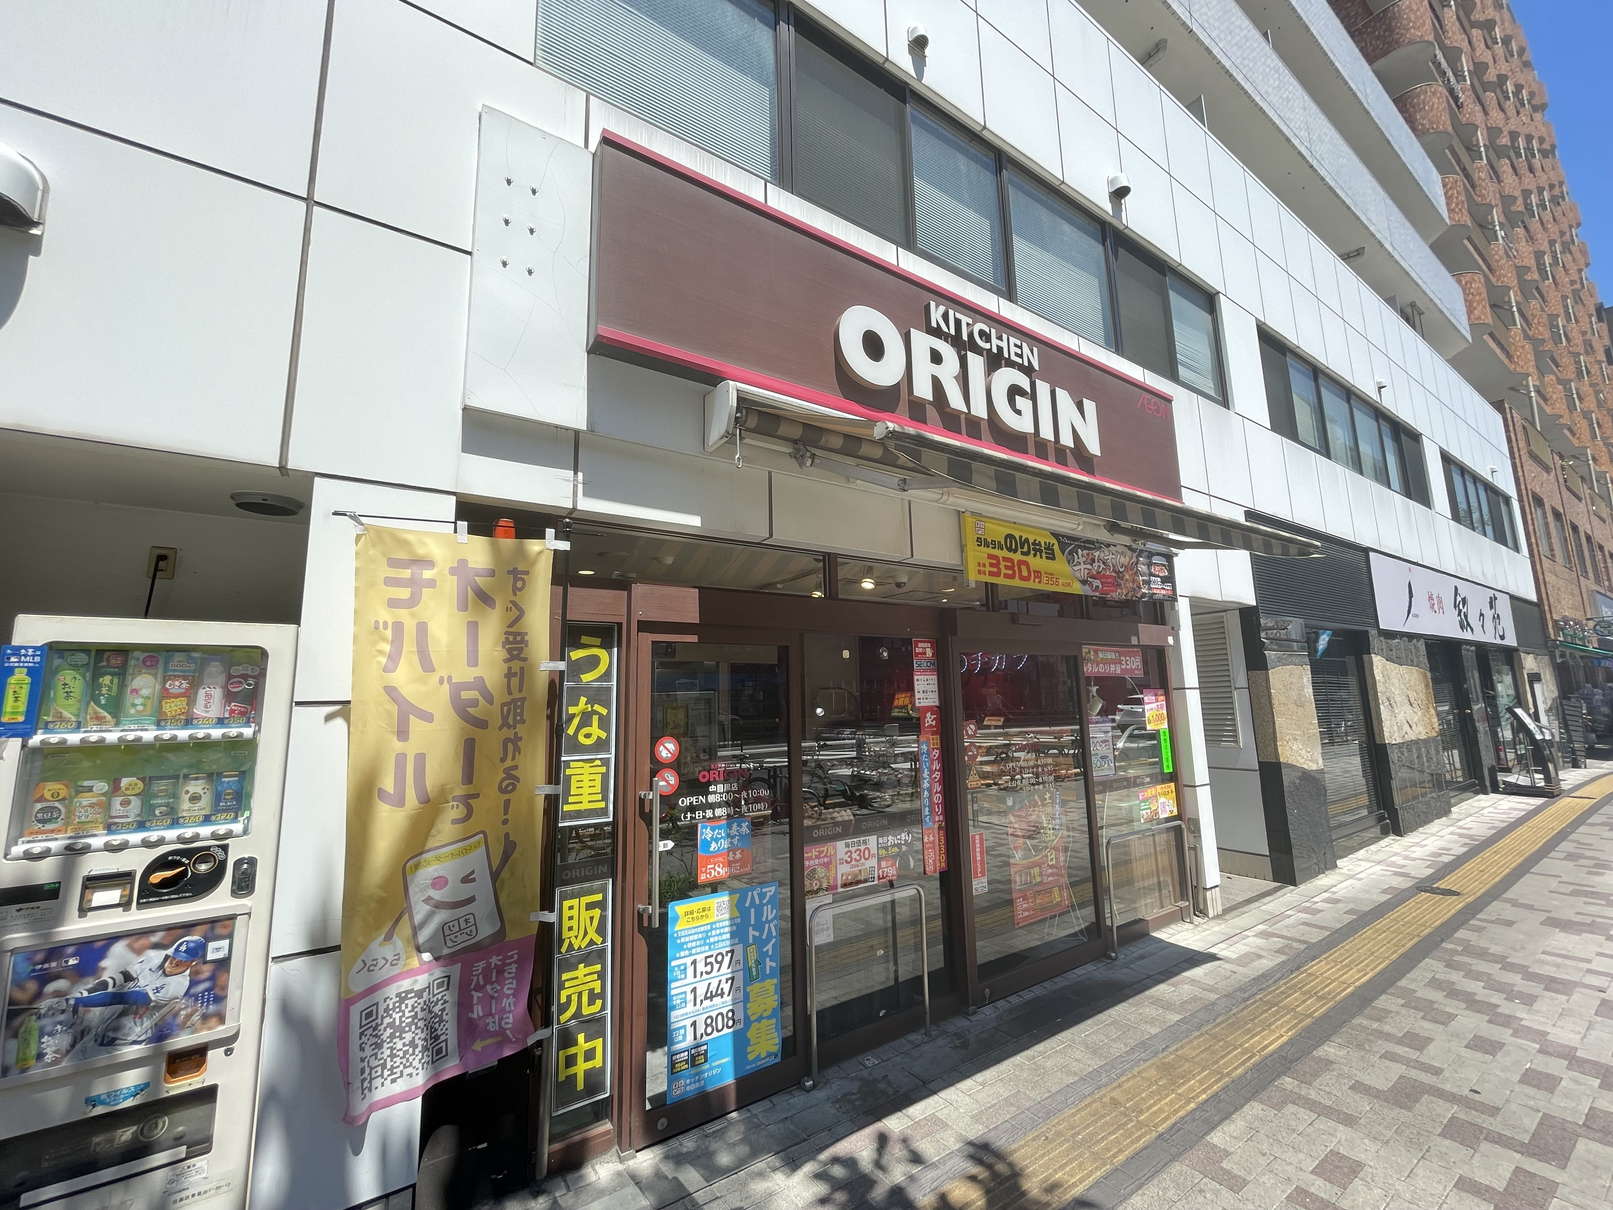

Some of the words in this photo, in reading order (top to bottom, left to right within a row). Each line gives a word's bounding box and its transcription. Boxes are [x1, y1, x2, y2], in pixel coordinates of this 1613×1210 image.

[929, 300, 1040, 371] KITCHEN
[838, 304, 1101, 457] ORIGIN
[975, 532, 1057, 561] タルタルのり弁当
[562, 634, 611, 812] うな重
[678, 795, 706, 807] OPEN
[813, 826, 842, 837] ORIGIN
[561, 863, 609, 880] ORIGIN
[744, 887, 761, 943] パート
[761, 885, 778, 976] アルバイト
[557, 892, 604, 1092] 販売中
[746, 977, 779, 1061] 募集
